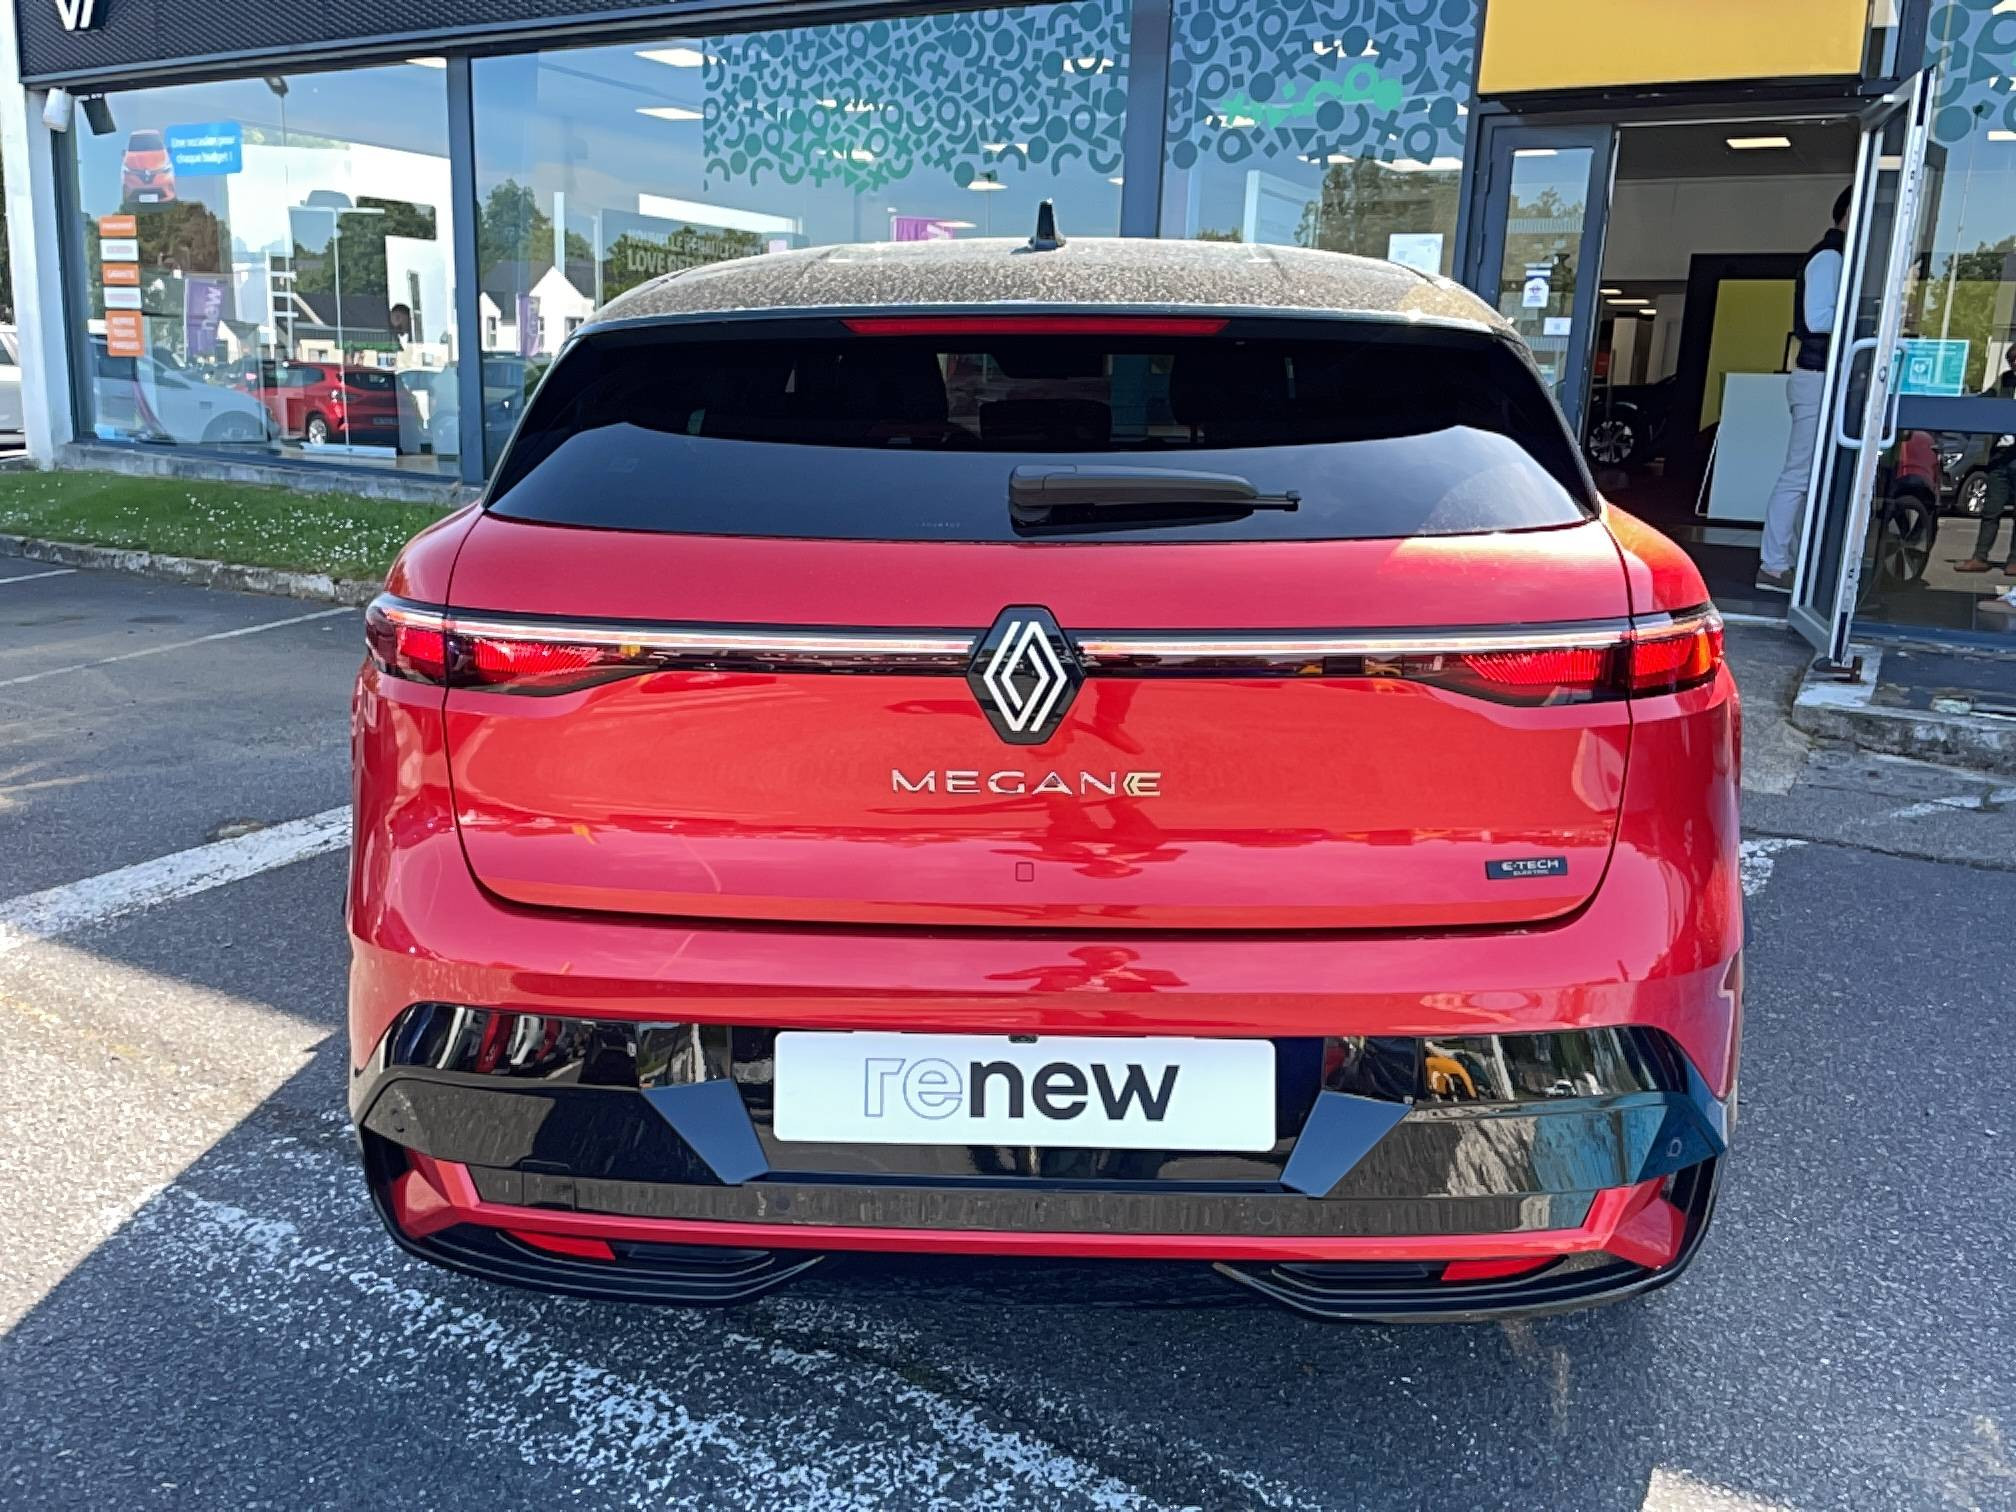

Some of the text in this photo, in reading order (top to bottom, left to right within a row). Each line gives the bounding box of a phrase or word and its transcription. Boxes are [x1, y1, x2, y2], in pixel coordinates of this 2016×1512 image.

[627, 248, 666, 274] LOVE
[891, 768, 1161, 797] MEGANE
[864, 1057, 1180, 1121] renew
